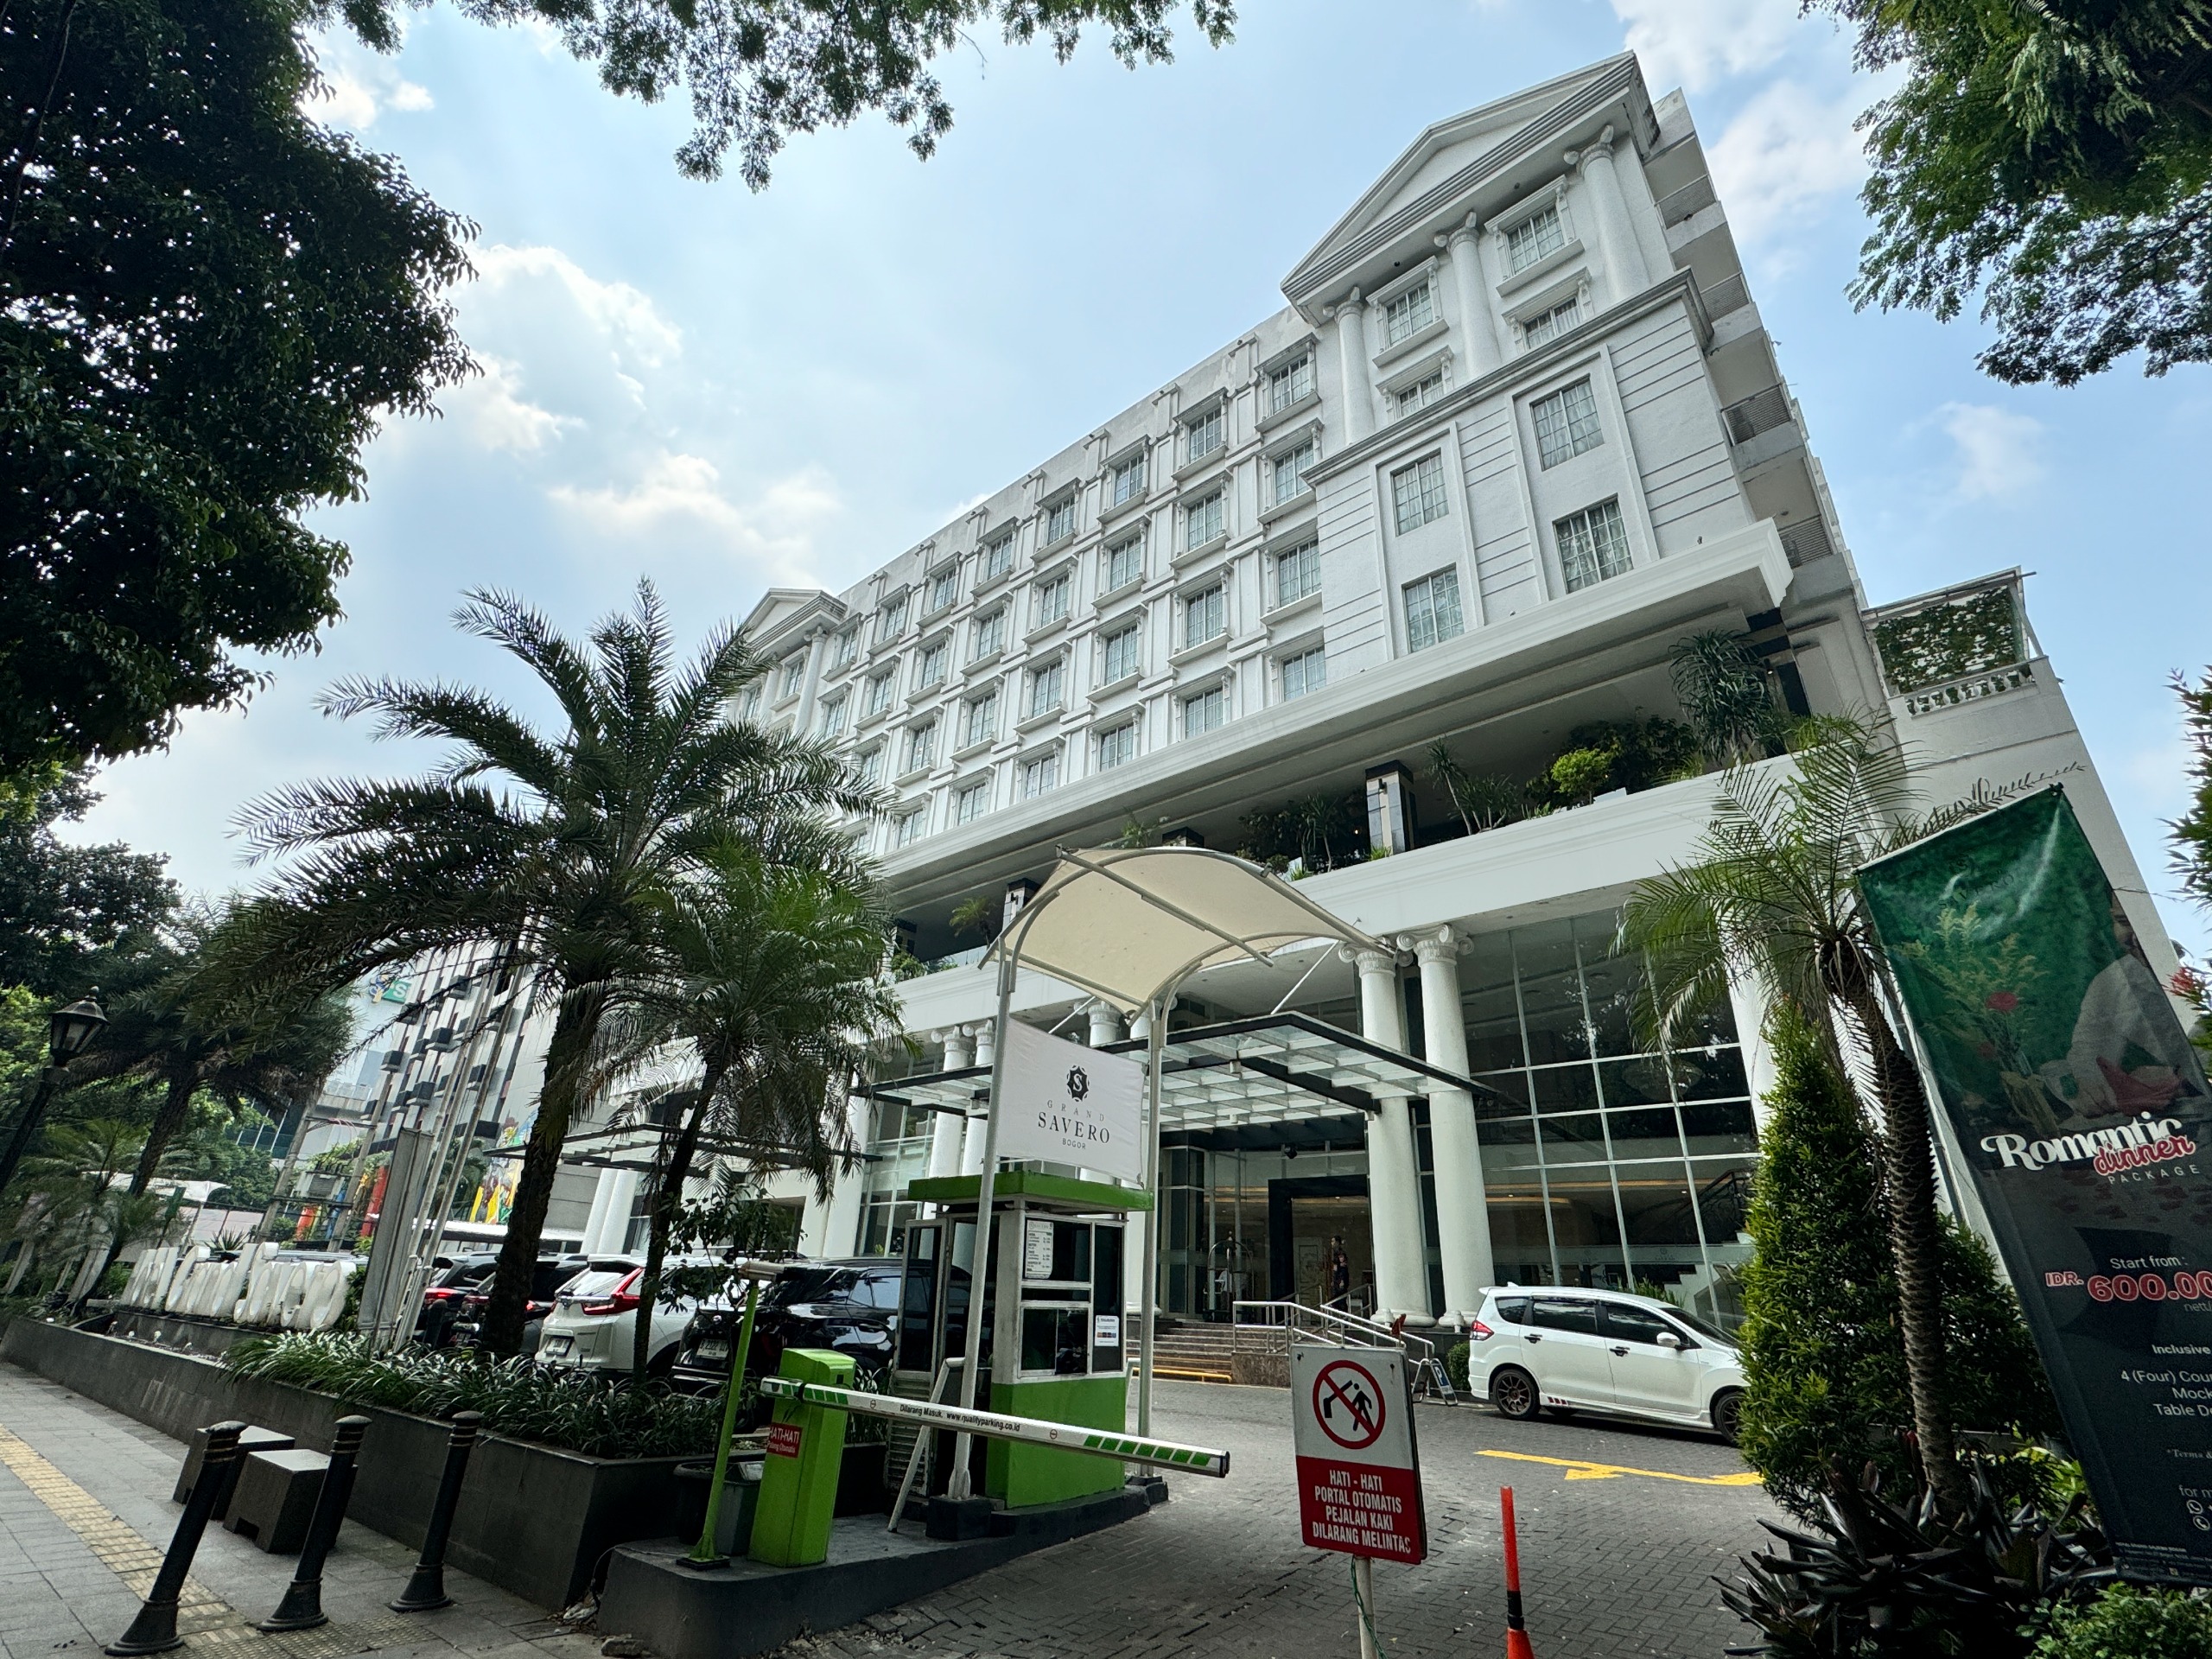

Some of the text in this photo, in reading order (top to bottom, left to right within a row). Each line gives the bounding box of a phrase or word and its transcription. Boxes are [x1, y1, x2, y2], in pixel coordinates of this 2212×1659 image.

[1047, 1099, 1104, 1122] GRAND
[1038, 1111, 1110, 1144] SAVERO
[1062, 1137, 1086, 1150] BOGOR
[1980, 1111, 2182, 1171] Romantic
[2093, 1135, 2196, 1176] dinner
[2107, 1164, 2200, 1185] PACKAGE
[2110, 1257, 2149, 1269] Start
[2150, 1255, 2182, 1268] from
[2045, 1271, 2084, 1287] IDR.
[2152, 1344, 2212, 1355] Inclusive
[1433, 1366, 1445, 1385] P
[2121, 1370, 2130, 1382] 4
[2132, 1370, 2177, 1384] (Four)
[899, 1403, 923, 1417] Dilarang
[2152, 1403, 2195, 1416] Table
[1329, 1470, 1351, 1487] HATI
[1360, 1473, 1382, 1492] HATI
[2178, 1484, 2198, 1497] for
[1314, 1485, 1402, 1514] PORTAL OTOMATIS
[1325, 1505, 1394, 1531] PEJALAN KAKI
[1313, 1521, 1411, 1554] DILARANG MELINTAS
